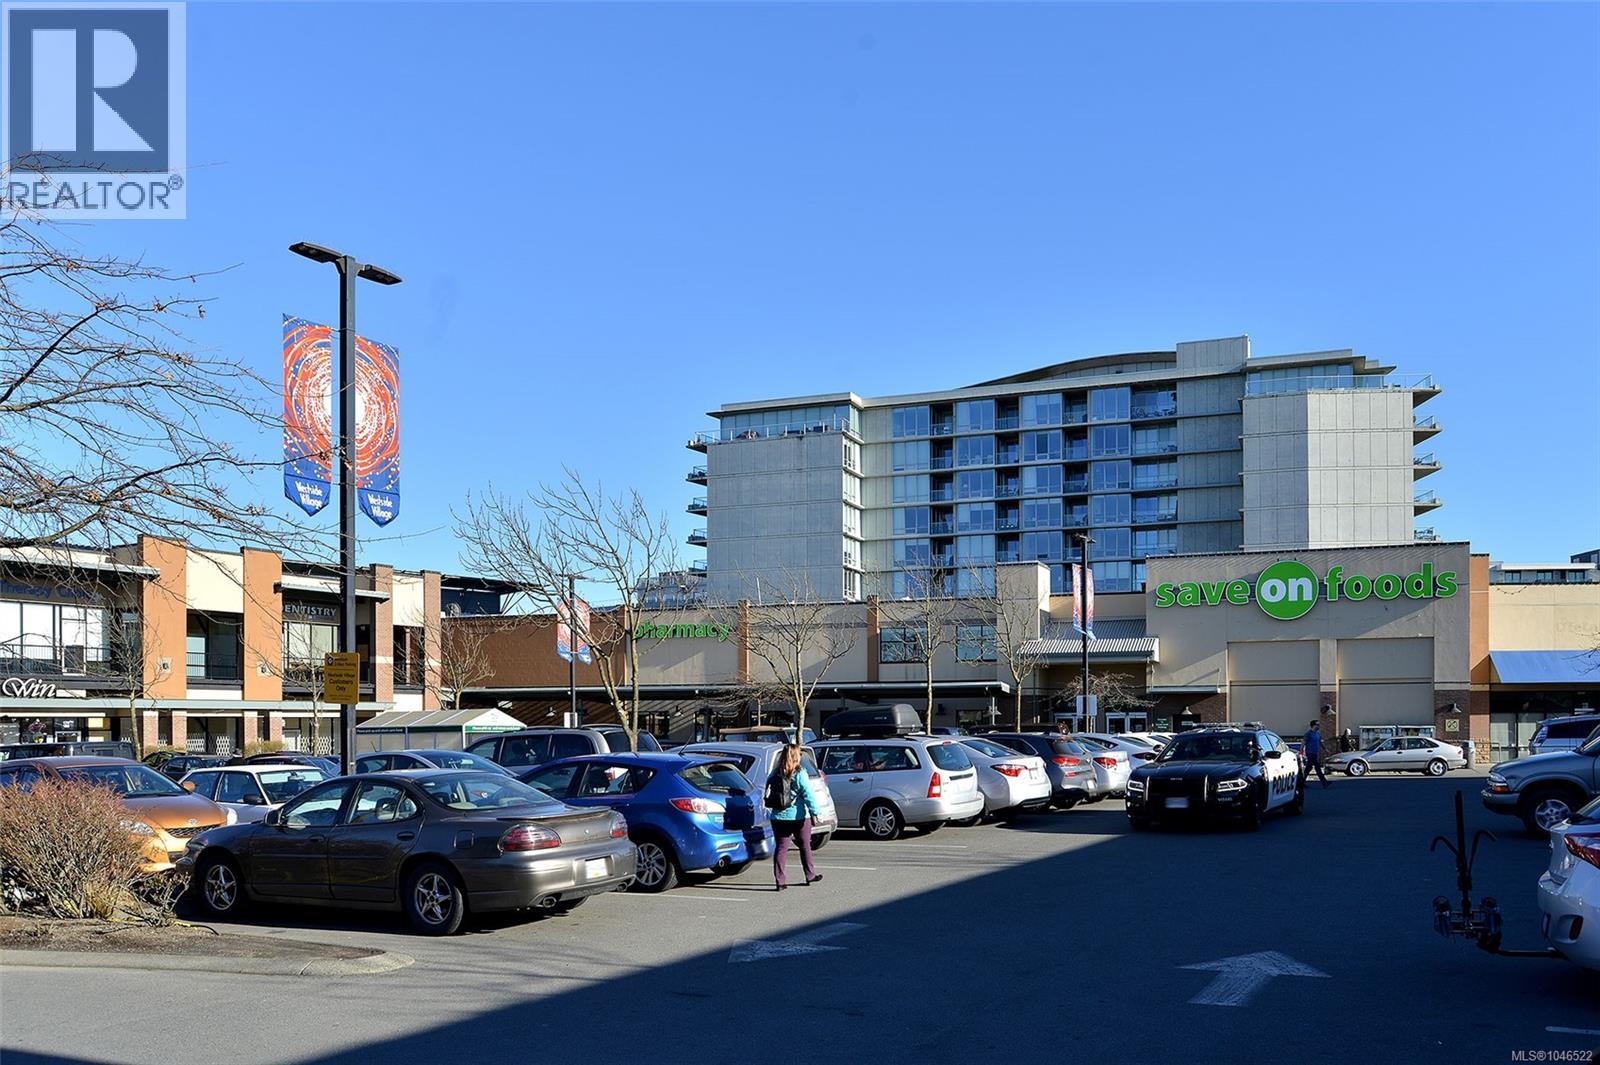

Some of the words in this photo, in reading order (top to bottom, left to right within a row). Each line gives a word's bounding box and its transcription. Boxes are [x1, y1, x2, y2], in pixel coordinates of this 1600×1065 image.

[300, 493, 323, 510] Village
[371, 505, 393, 521] Village
[1155, 579, 1250, 607] save
[1260, 577, 1313, 603] on
[1324, 562, 1458, 601] foods
[284, 604, 337, 616] ENTISTRY
[2, 677, 56, 697] Win
[1272, 771, 1296, 795] POLICE
